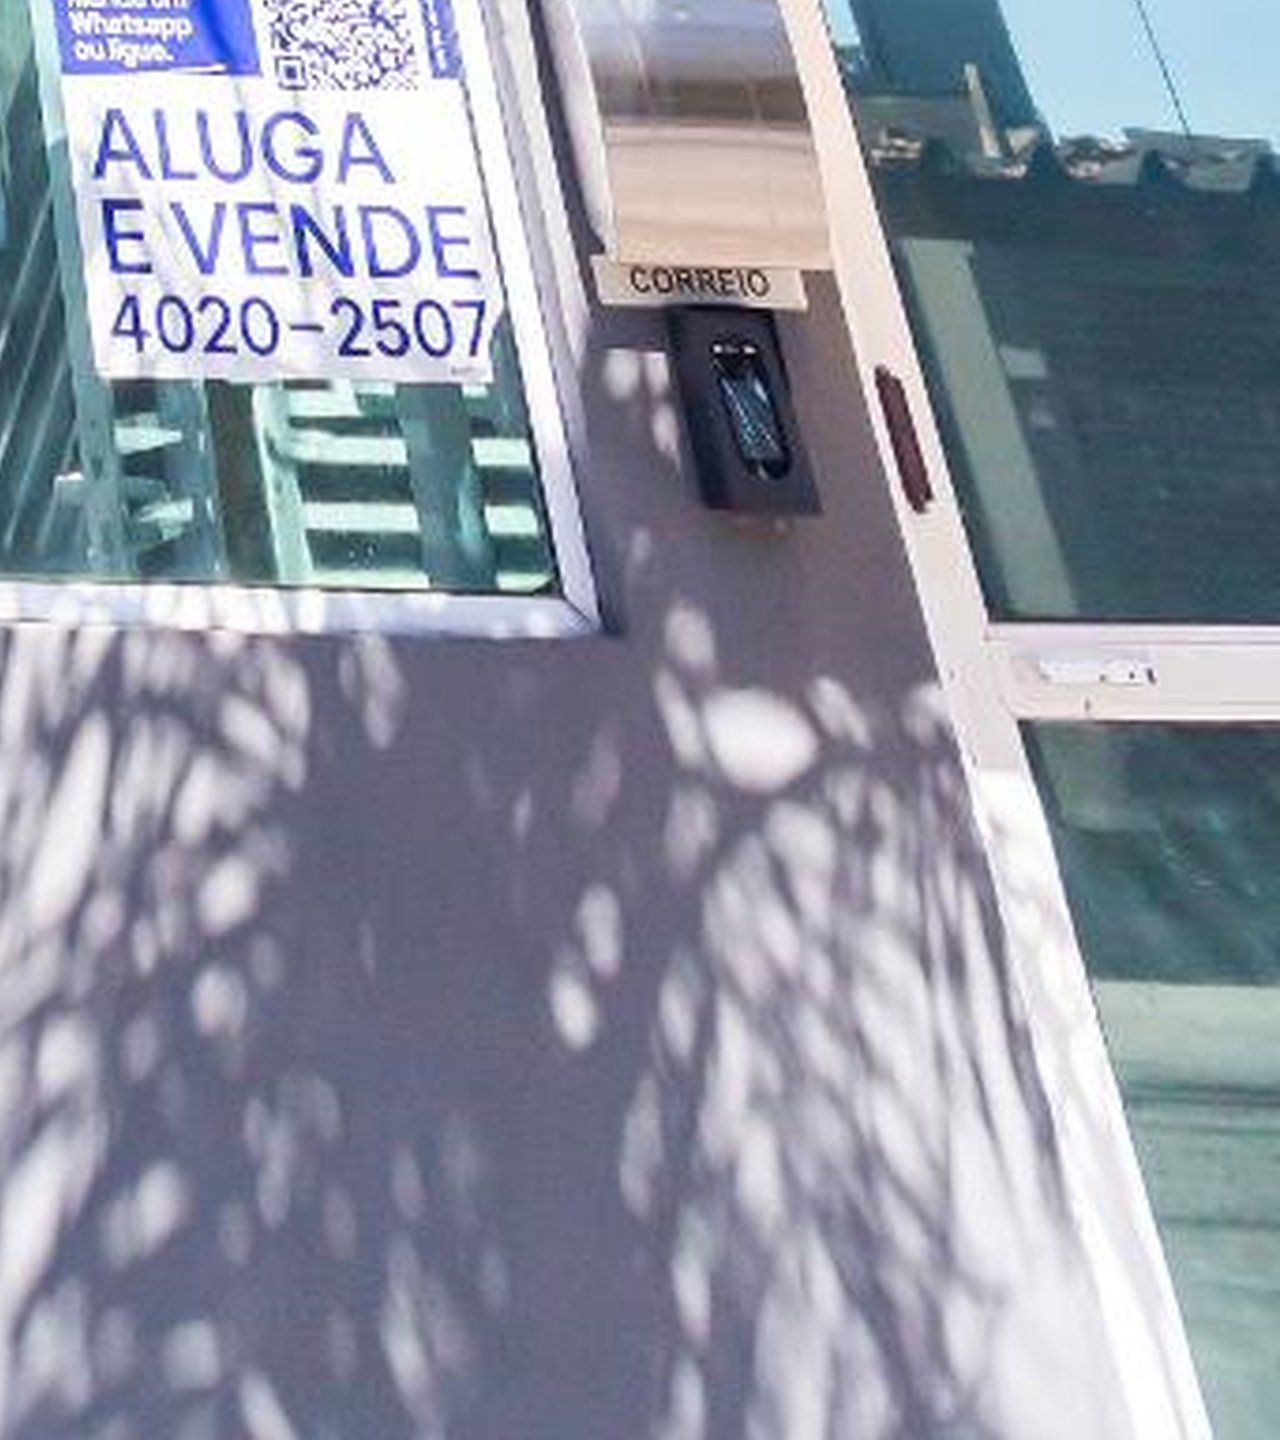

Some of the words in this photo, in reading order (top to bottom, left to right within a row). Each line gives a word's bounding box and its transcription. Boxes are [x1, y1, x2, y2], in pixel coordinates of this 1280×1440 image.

[74, 39, 106, 62] ou
[92, 107, 398, 184] ALUGA
[100, 198, 154, 276] E
[169, 201, 483, 281] VENDE
[629, 265, 772, 297] CORREIO
[109, 294, 488, 359] 4020-2507
